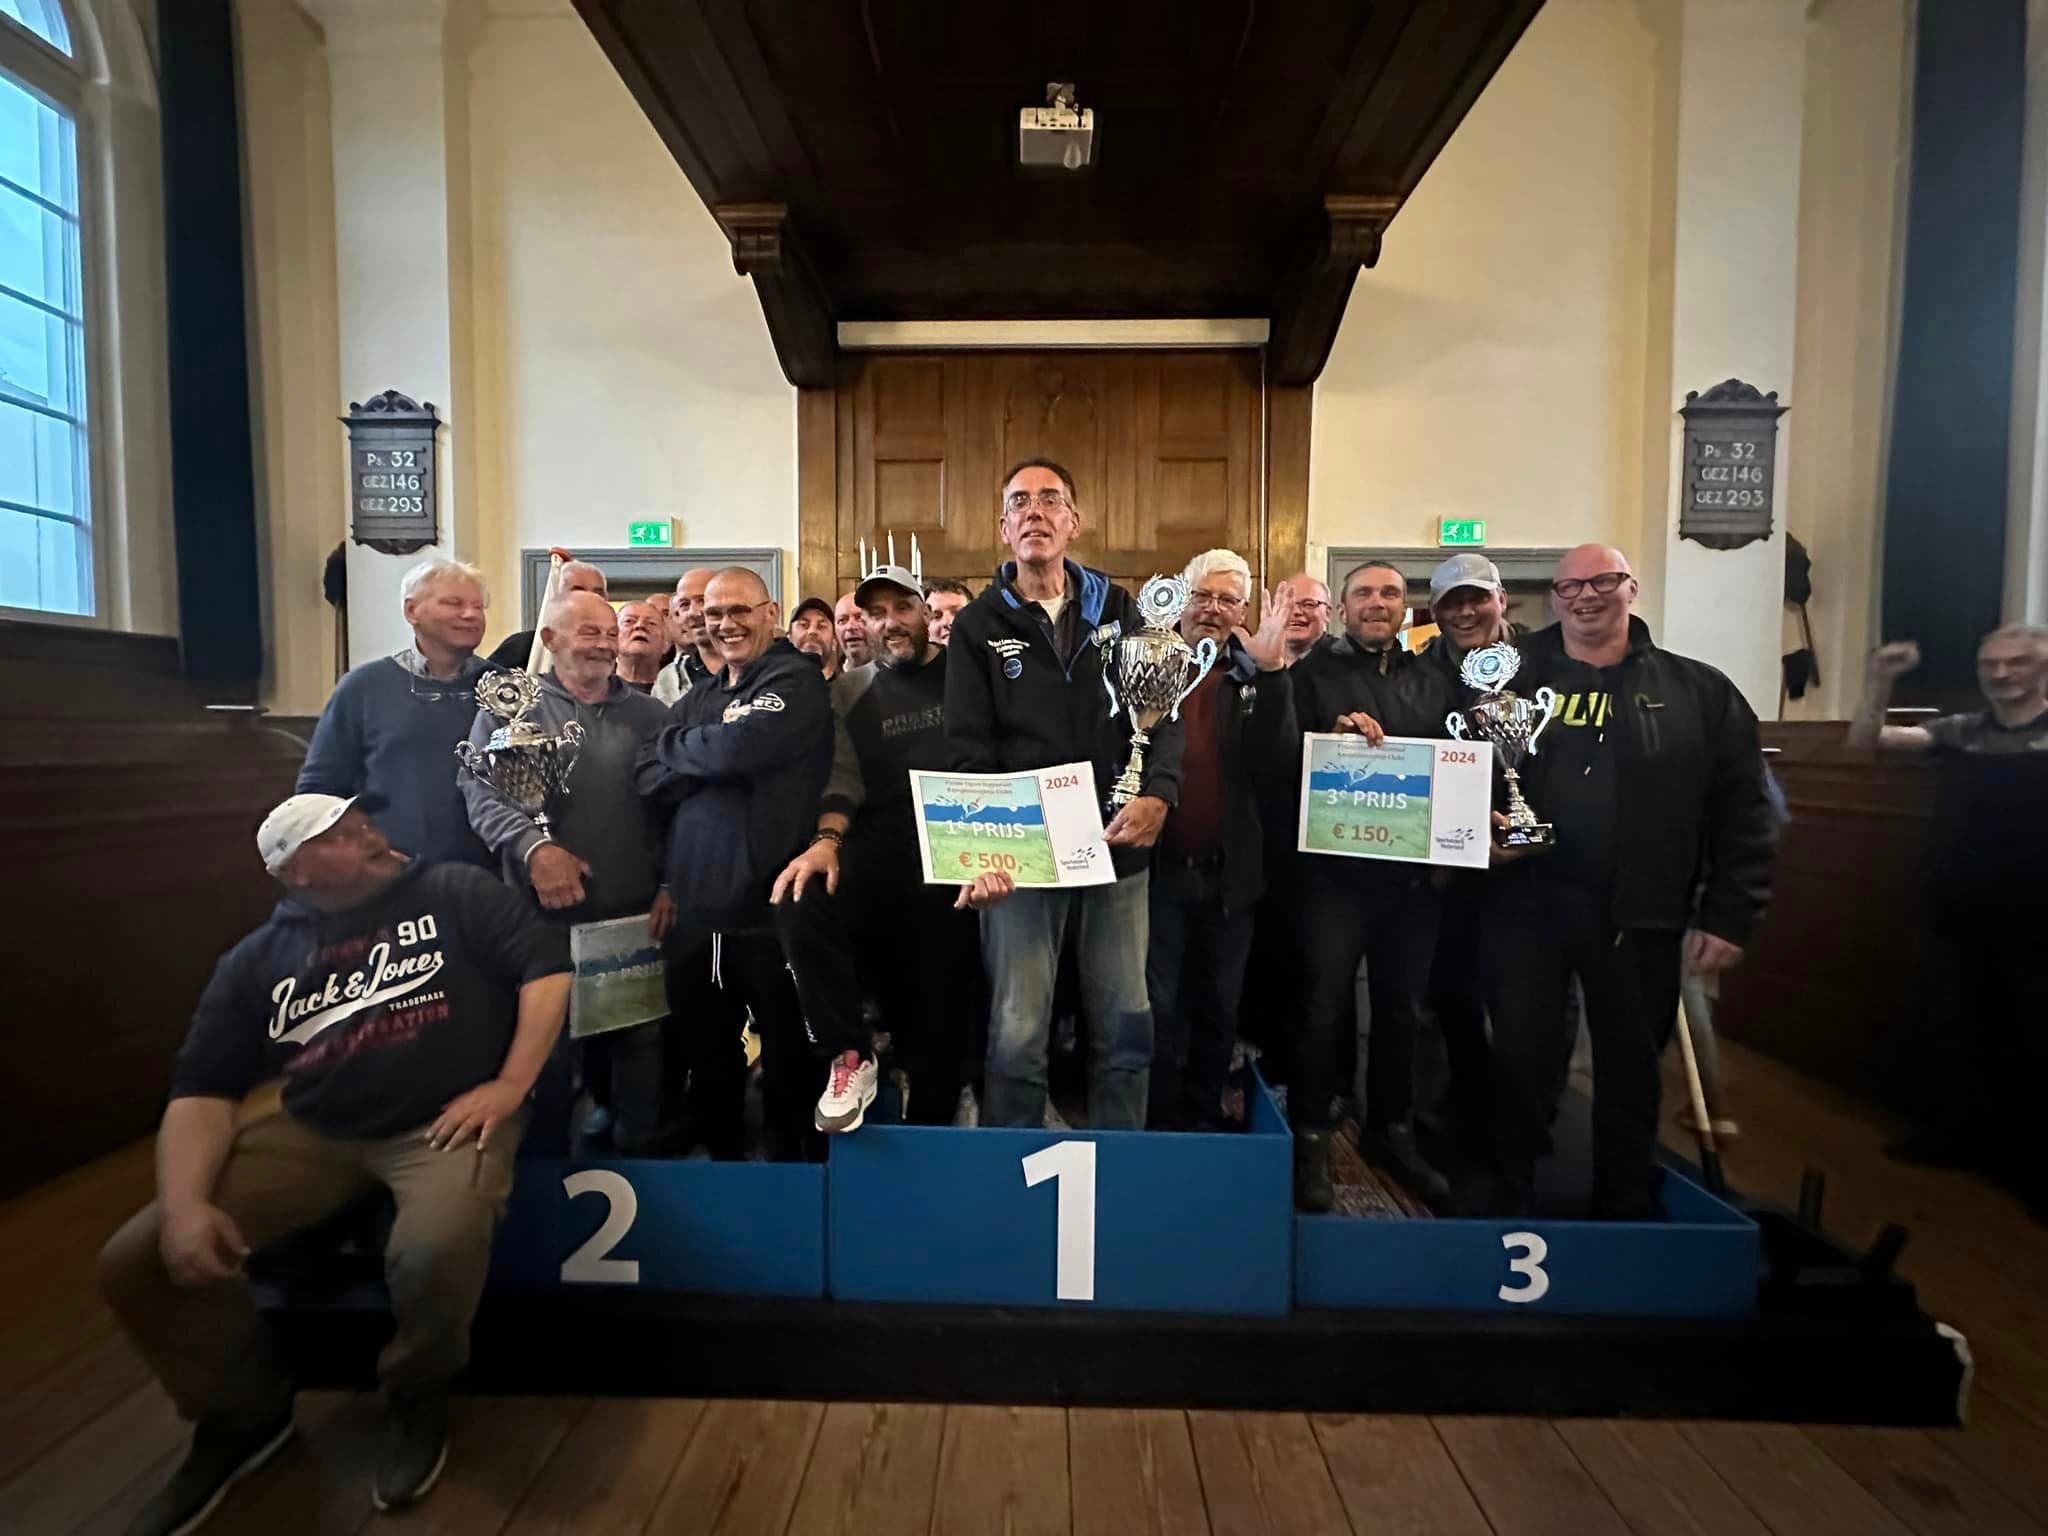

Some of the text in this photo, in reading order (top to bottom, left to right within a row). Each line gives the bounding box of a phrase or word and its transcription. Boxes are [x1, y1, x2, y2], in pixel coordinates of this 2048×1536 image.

[391, 451, 415, 467] 32
[1731, 443, 1755, 459] 32
[390, 474, 420, 490] 146
[1732, 466, 1763, 482] 146
[388, 497, 423, 512] 293
[1727, 490, 1764, 506] 293
[1440, 750, 1477, 765] 2024
[1044, 775, 1079, 790] 2024
[1353, 792, 1408, 809] PRIJS
[973, 821, 1025, 839] PRIJS
[1332, 823, 1406, 847] € 150,-
[959, 852, 1030, 874] € 500,-
[397, 914, 438, 947] 90
[560, 1169, 639, 1283] 2
[1021, 1140, 1096, 1301] 1
[1498, 1231, 1549, 1304] 3
